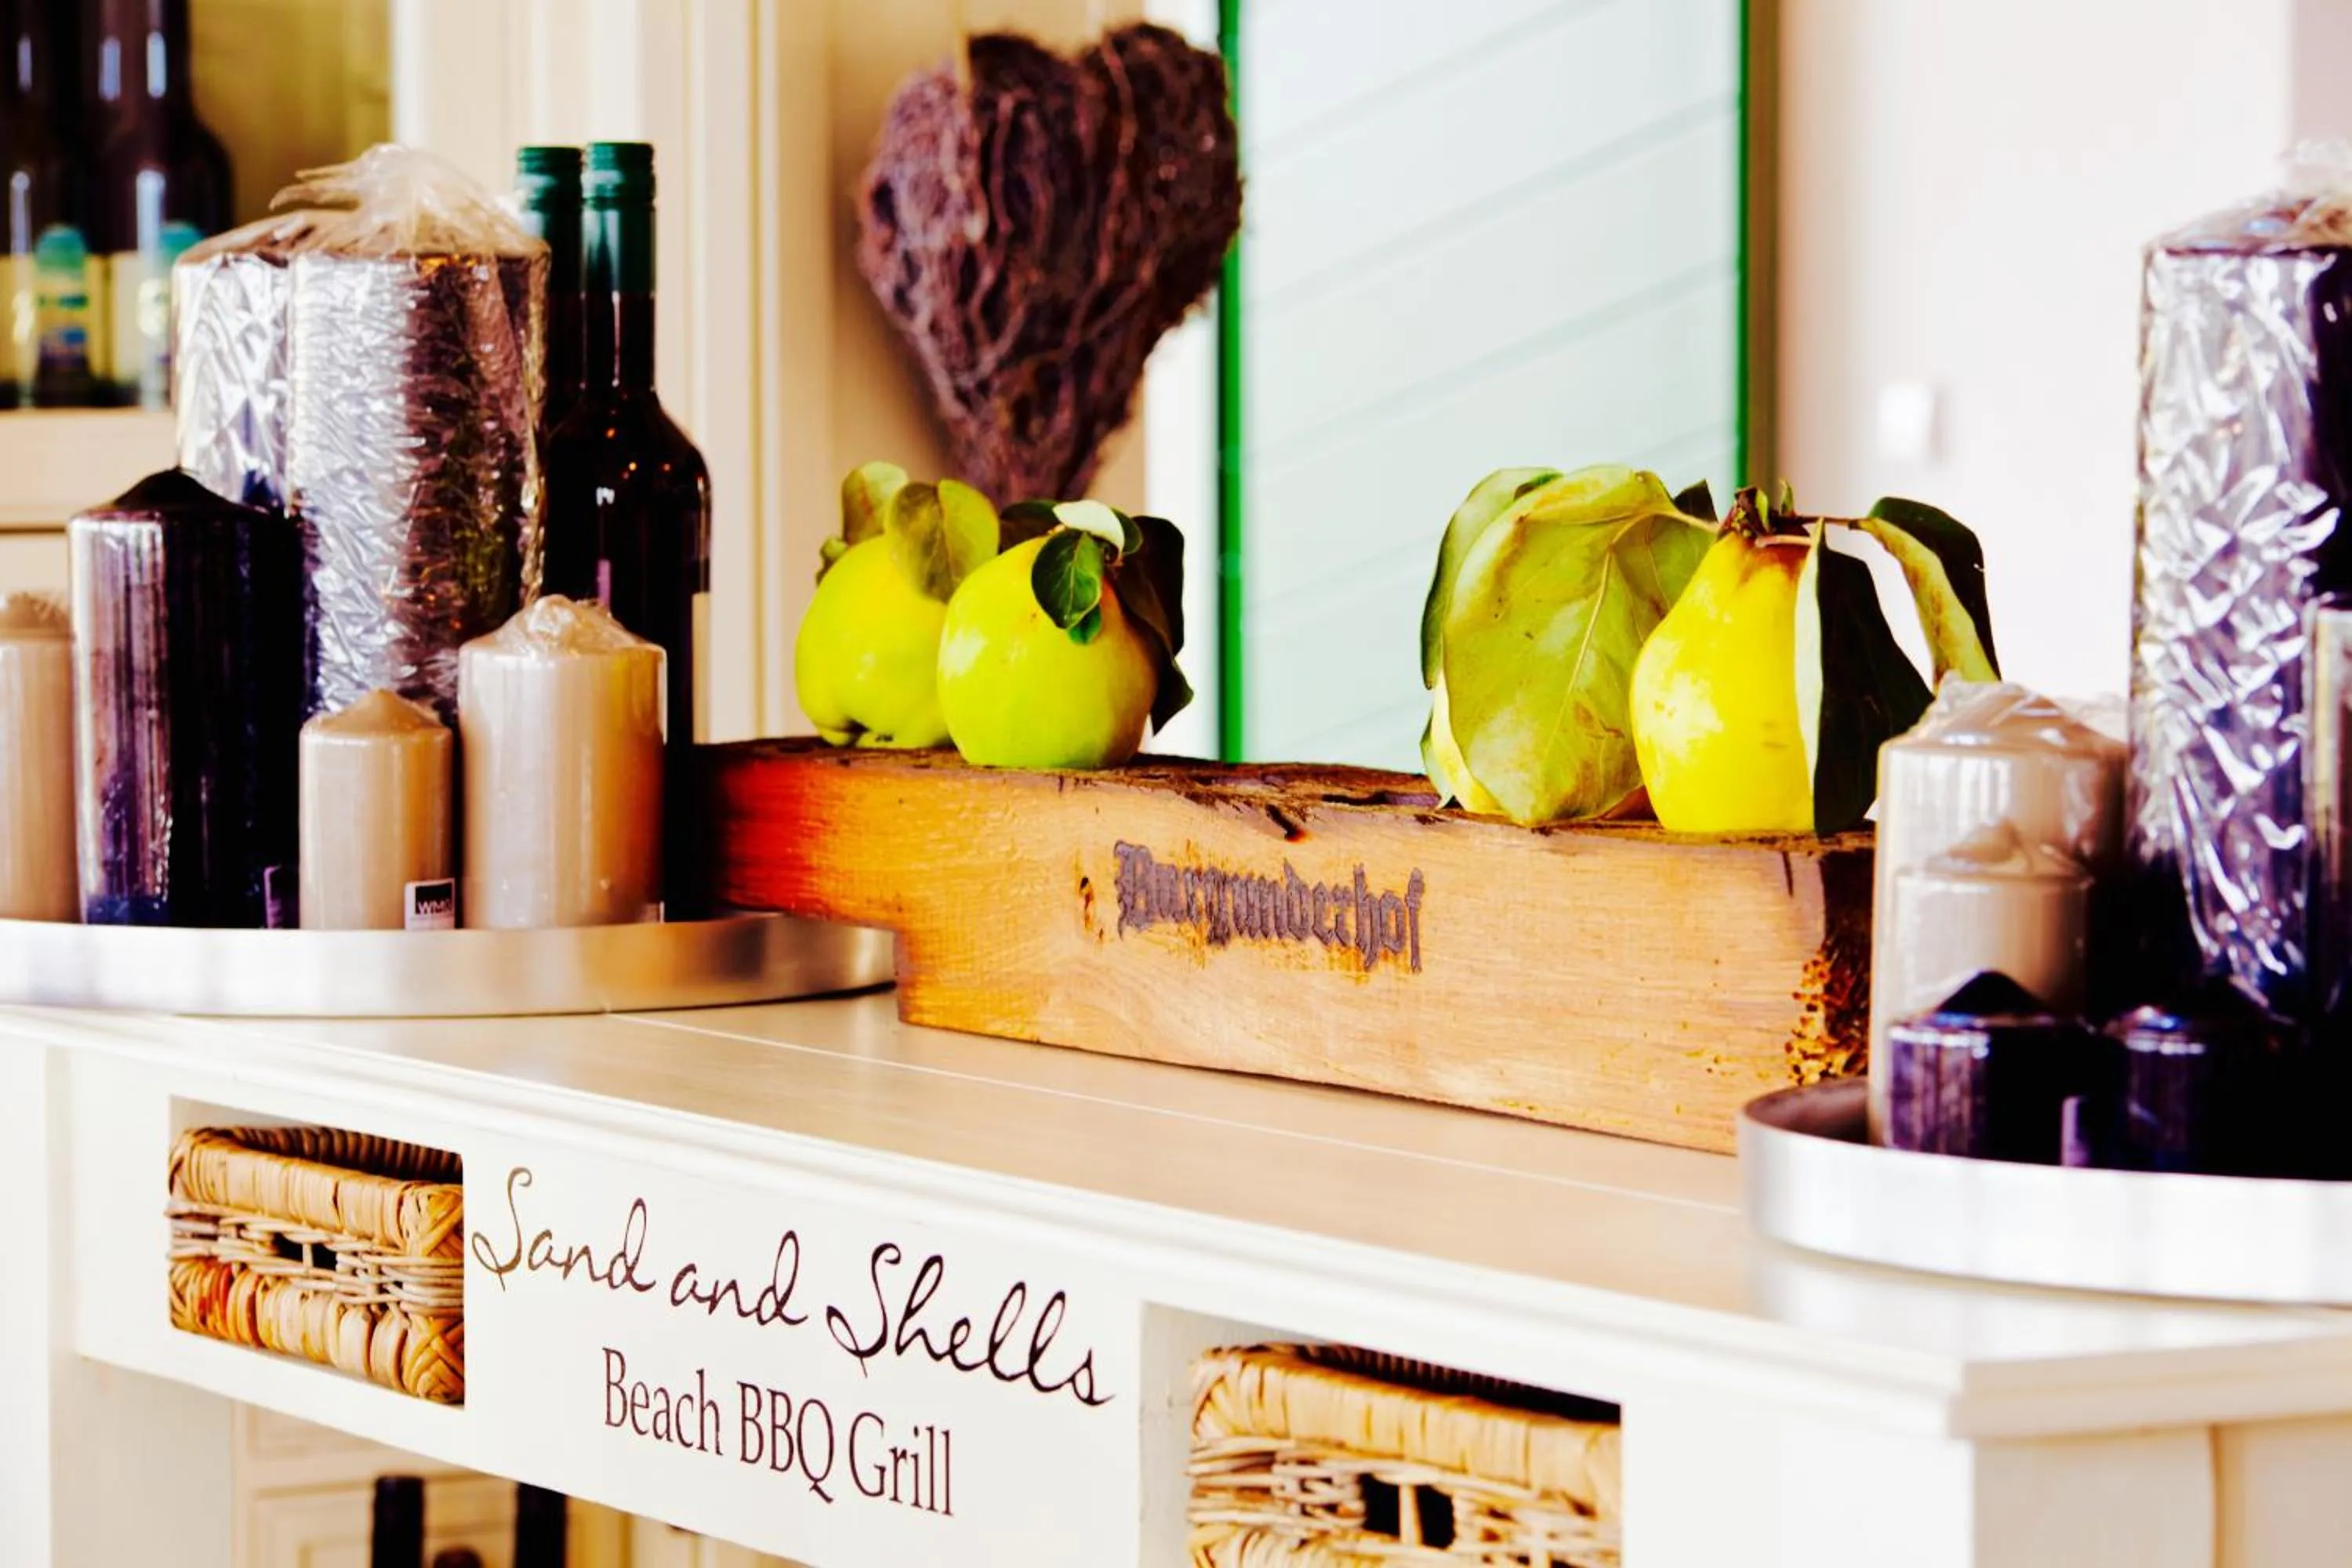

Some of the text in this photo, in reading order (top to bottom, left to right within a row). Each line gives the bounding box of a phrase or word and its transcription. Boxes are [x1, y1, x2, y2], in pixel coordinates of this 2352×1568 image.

[471, 1167, 1115, 1408] Sand and Shells
[601, 1346, 954, 1517] Beach BBQ Grill
